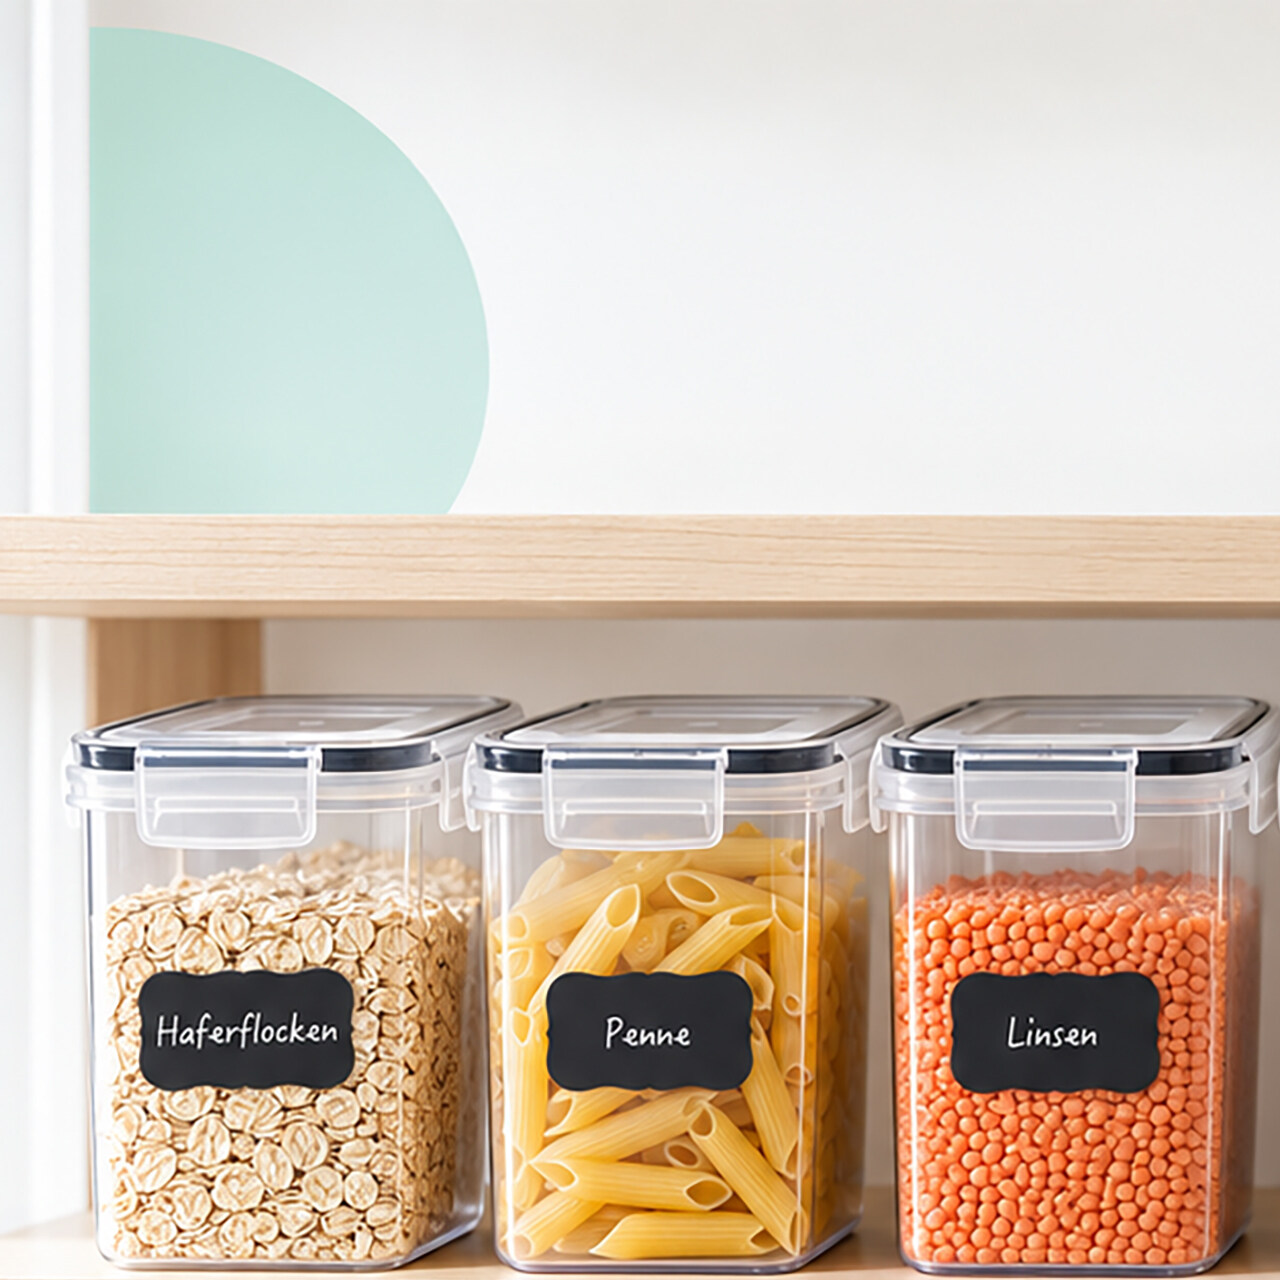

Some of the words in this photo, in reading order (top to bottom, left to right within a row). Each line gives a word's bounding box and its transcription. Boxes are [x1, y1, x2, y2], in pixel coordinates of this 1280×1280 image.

[156, 1011, 338, 1050] Haferflocken
[605, 1016, 691, 1049] Penne
[1007, 1016, 1097, 1049] Linsen
